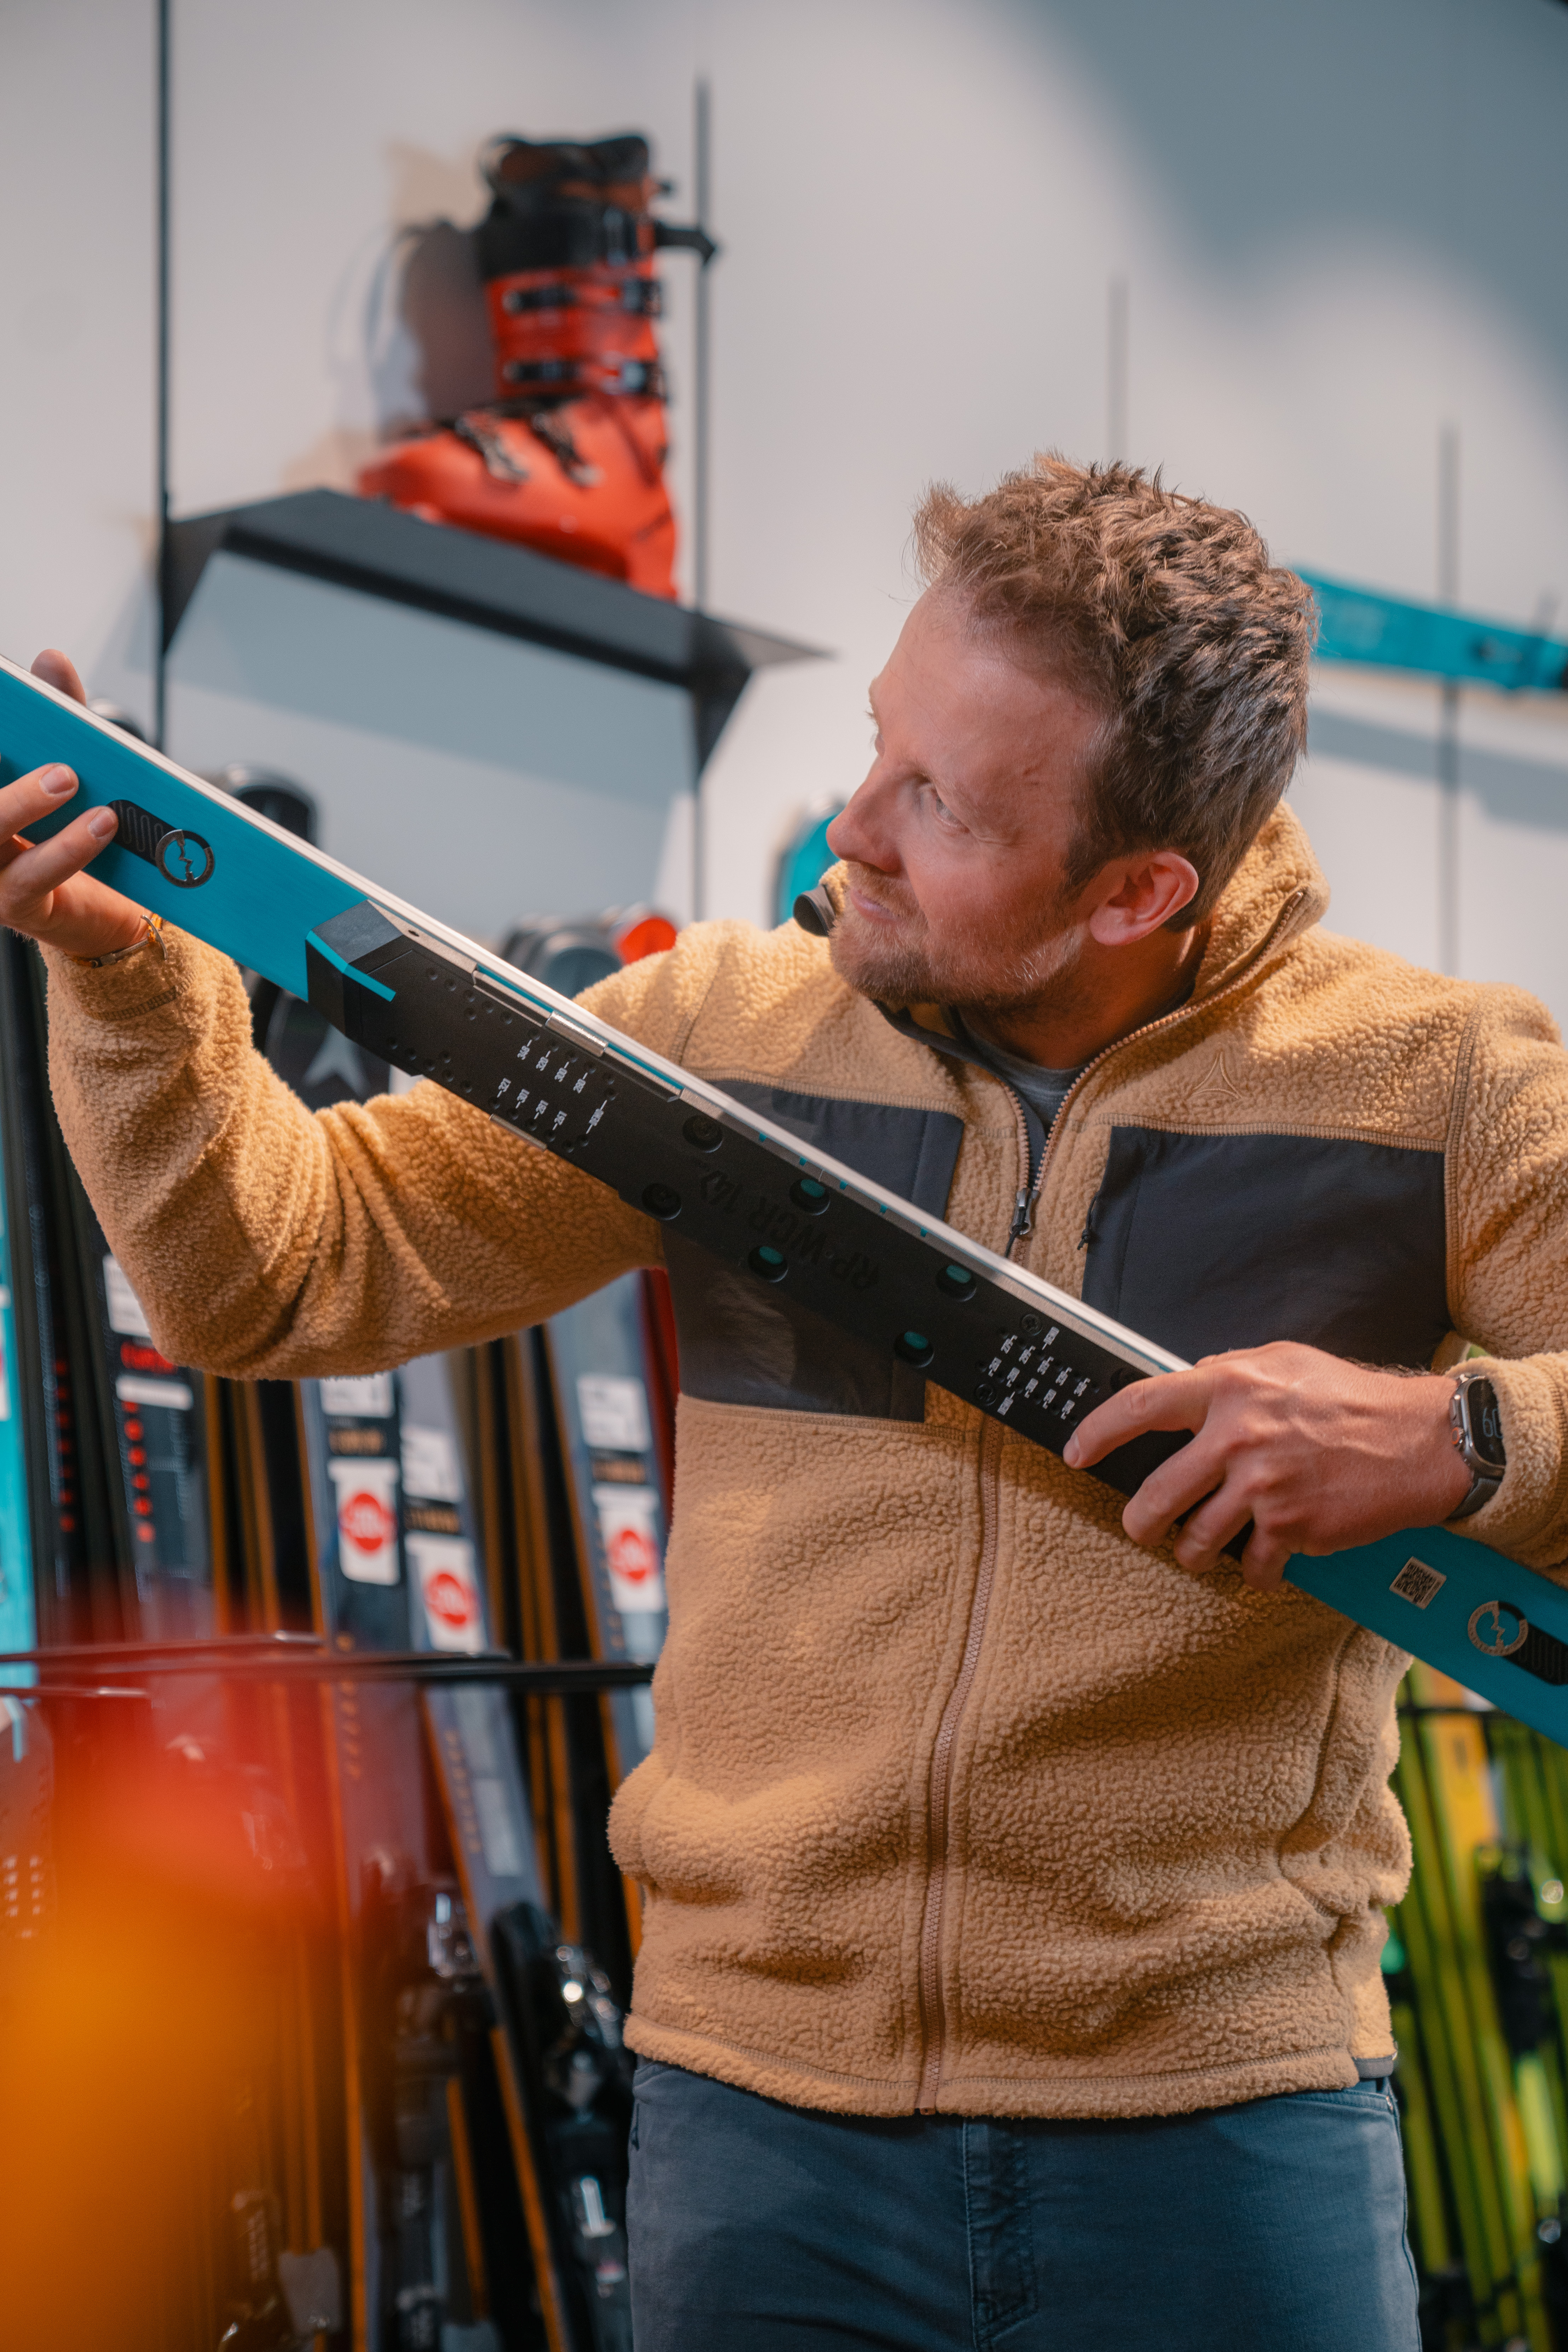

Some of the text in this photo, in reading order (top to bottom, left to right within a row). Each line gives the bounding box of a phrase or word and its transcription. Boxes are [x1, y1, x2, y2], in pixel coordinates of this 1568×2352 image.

[517, 1045, 530, 1060] 348
[536, 1057, 549, 1071] 320
[554, 1068, 567, 1082] 300
[498, 1078, 511, 1092] 321
[573, 1079, 586, 1093] 280
[517, 1089, 530, 1103] 301
[536, 1100, 548, 1114] 281
[554, 1111, 567, 1125] 261
[589, 1109, 604, 1126] DEMO
[749, 1197, 827, 1265] WCR
[1043, 1327, 1059, 1345] DEMO
[1001, 1339, 1013, 1354] 279
[1019, 1349, 1031, 1364] 299
